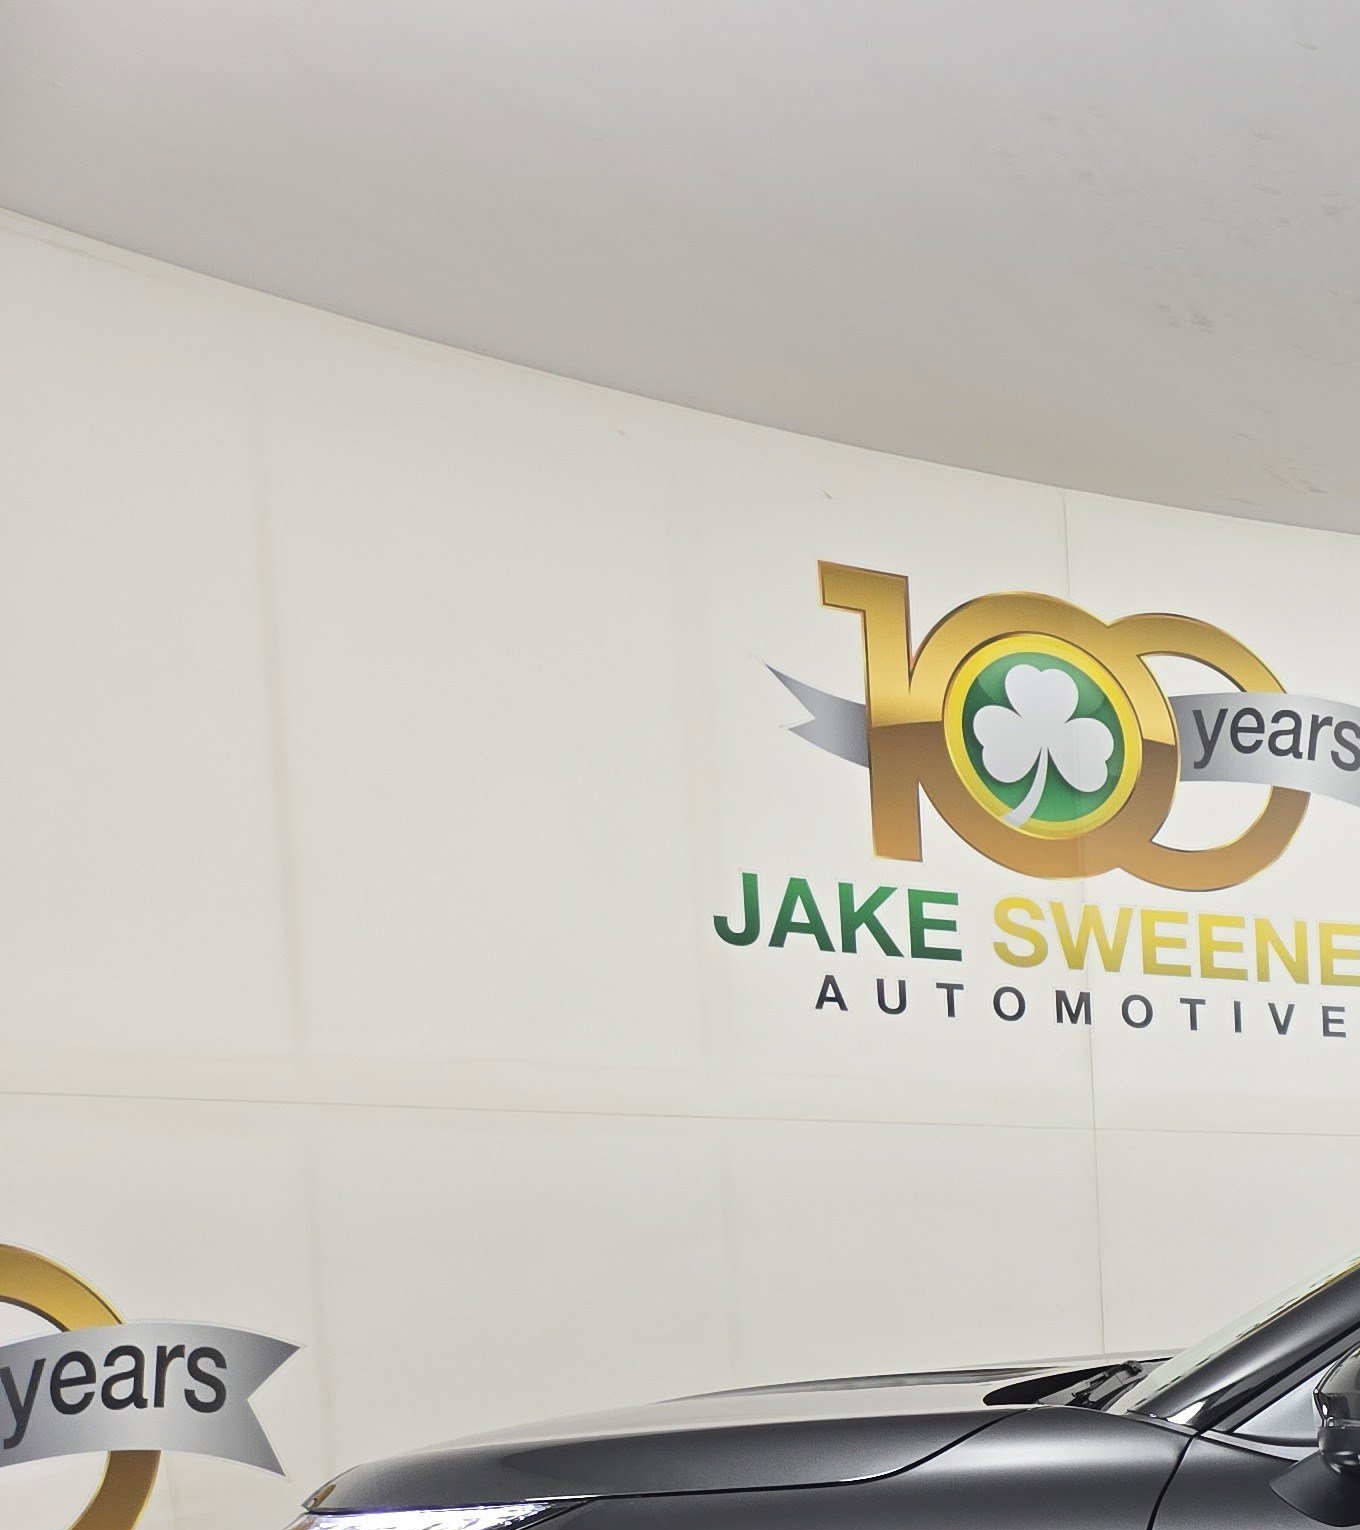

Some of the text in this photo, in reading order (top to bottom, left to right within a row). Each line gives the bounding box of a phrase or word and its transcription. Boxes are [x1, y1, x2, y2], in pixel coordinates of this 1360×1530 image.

[712, 871, 963, 962] JAKE
[815, 974, 1347, 1038] AUTOMOTIVE
[1, 1344, 228, 1450] years
